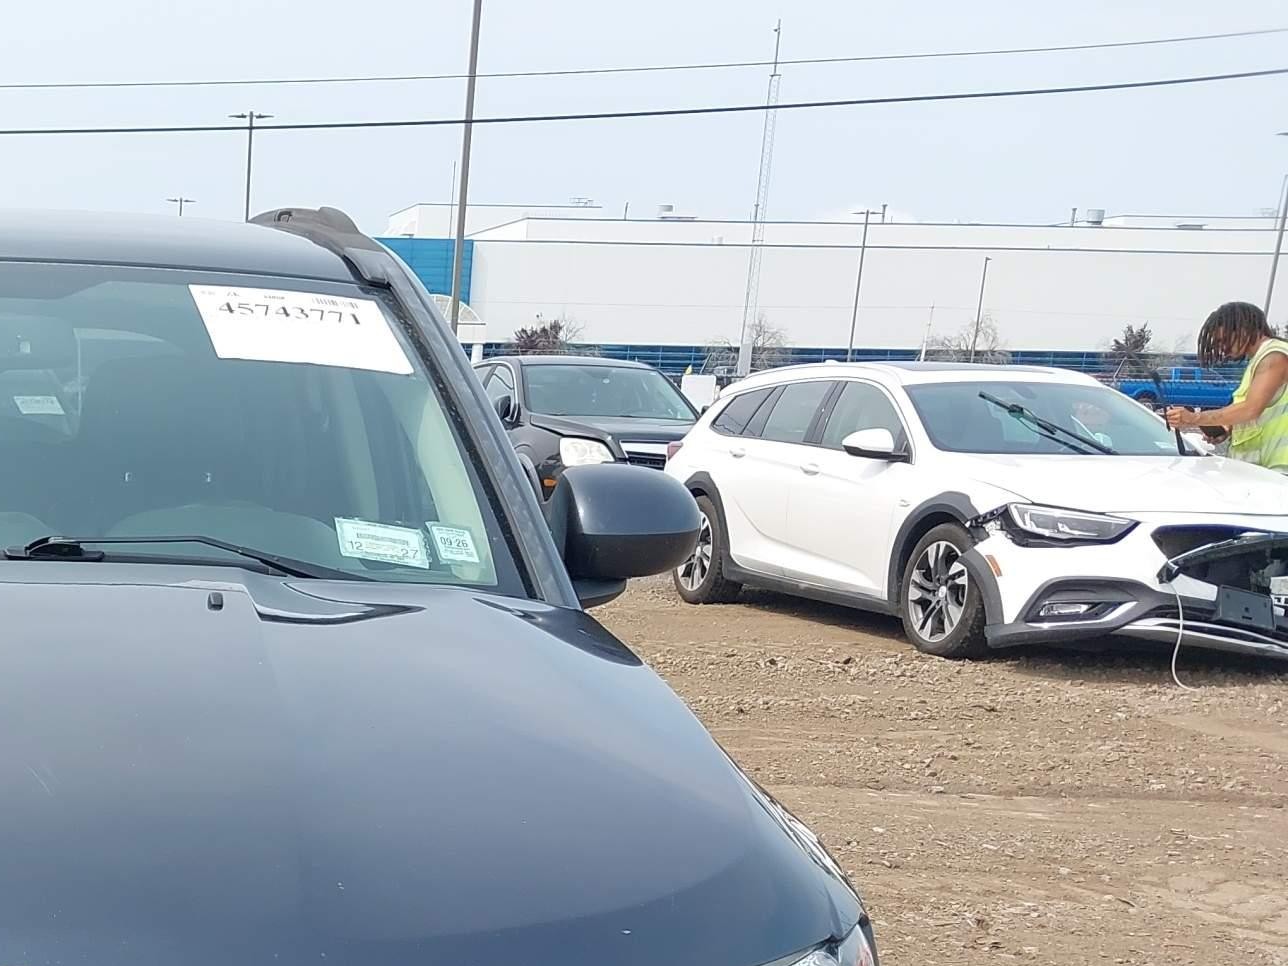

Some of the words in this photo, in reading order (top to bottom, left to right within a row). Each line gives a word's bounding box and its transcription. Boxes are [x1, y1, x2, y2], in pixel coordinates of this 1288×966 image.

[218, 302, 361, 325] 45743771
[348, 540, 364, 551] 12
[401, 548, 419, 559] 27
